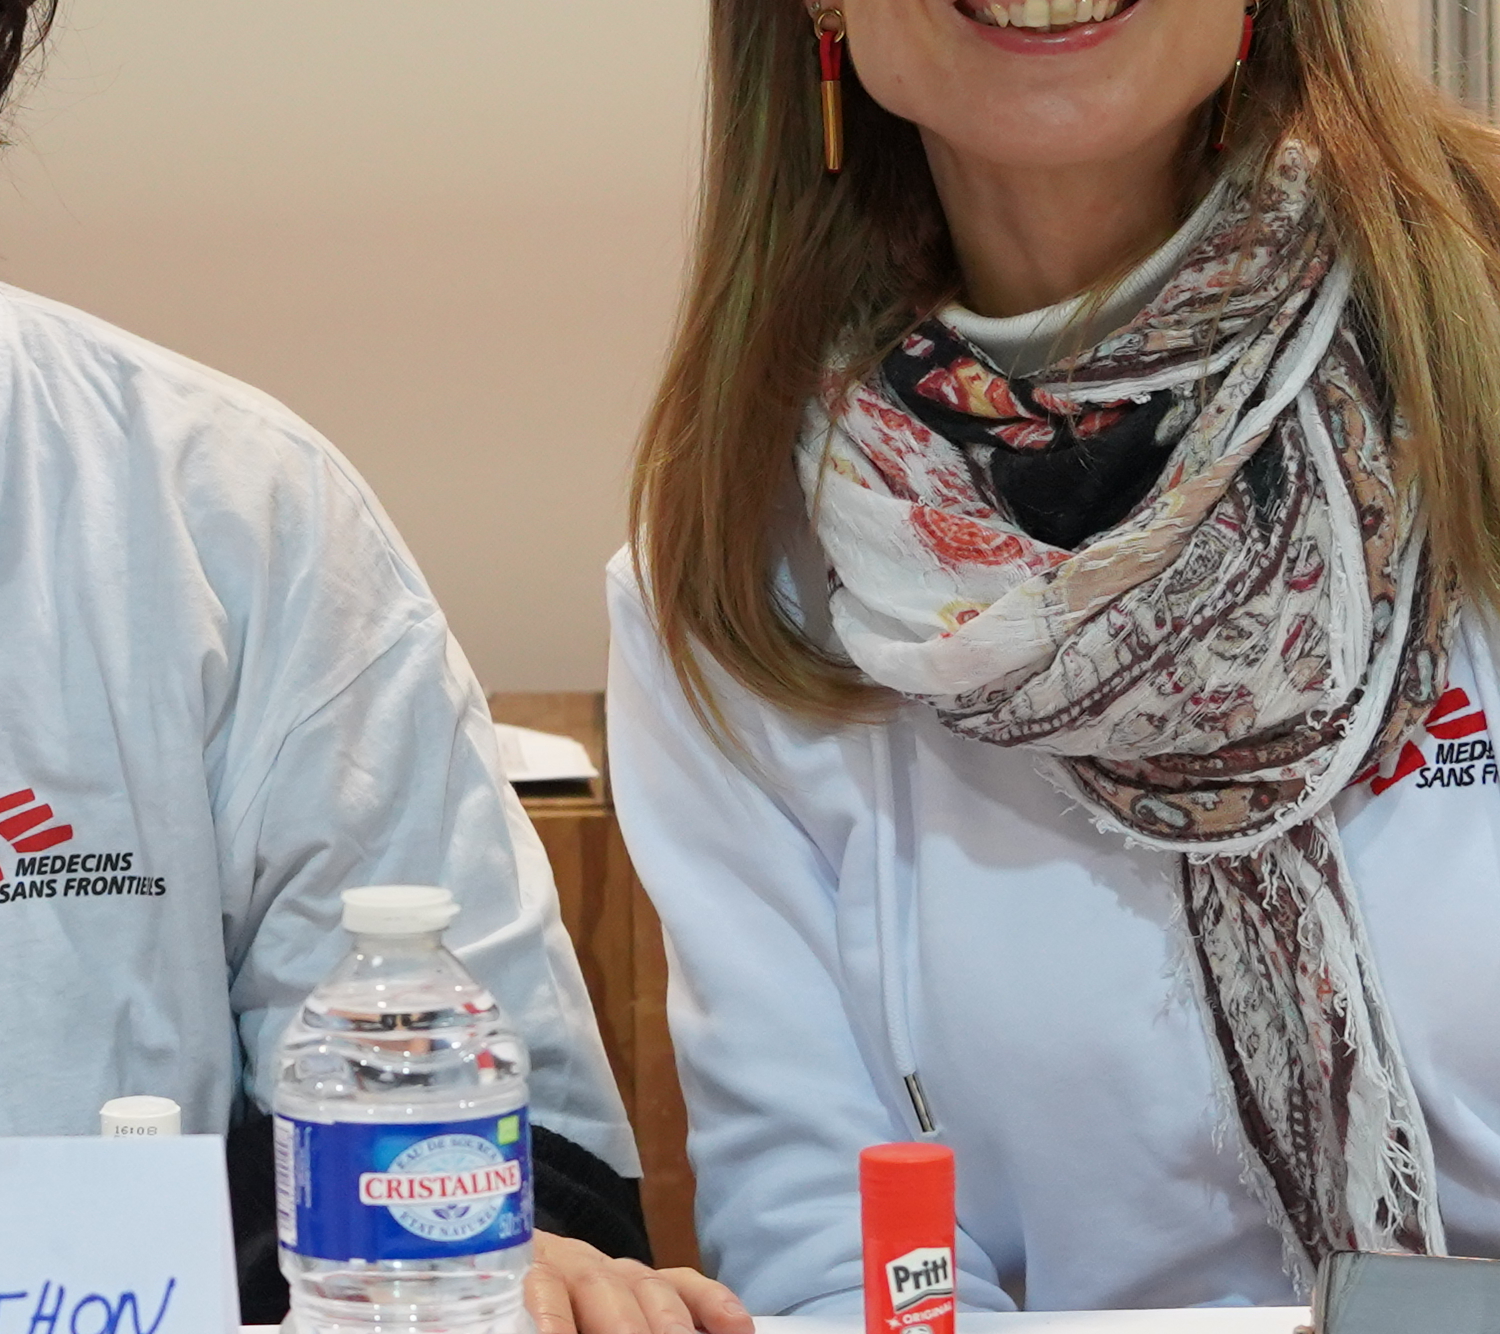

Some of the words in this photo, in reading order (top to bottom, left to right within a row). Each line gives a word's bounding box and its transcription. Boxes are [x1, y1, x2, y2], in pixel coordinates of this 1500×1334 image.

[1416, 763, 1477, 789] SANS
[14, 852, 134, 878] MEDECINS
[363, 1163, 519, 1201] CRISTALINE
[892, 1255, 949, 1293] Pritt
